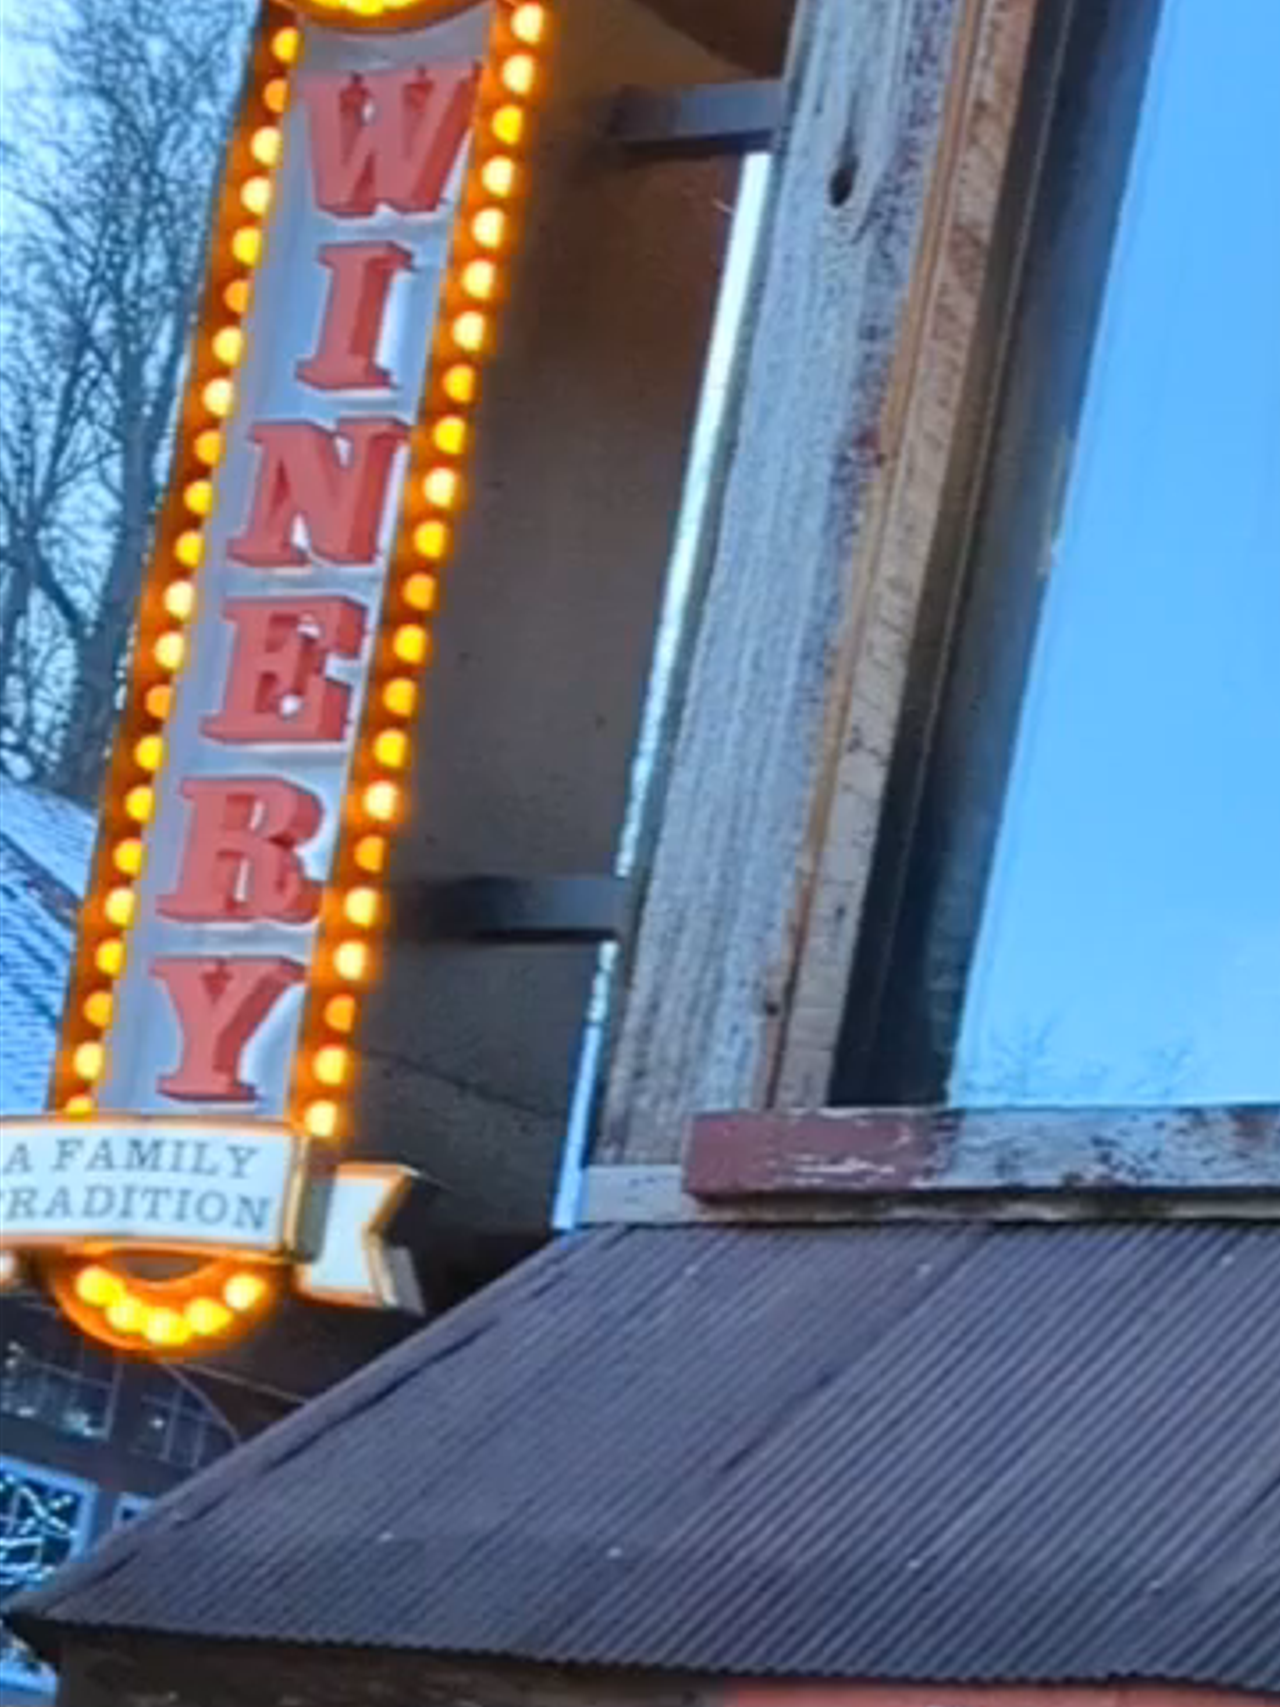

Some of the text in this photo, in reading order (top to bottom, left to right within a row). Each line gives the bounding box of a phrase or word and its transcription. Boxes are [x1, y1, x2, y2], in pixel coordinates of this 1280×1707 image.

[150, 59, 484, 1101] WINERY
[2, 1137, 260, 1179] A FAMILY
[0, 1186, 271, 1230] RADITION
